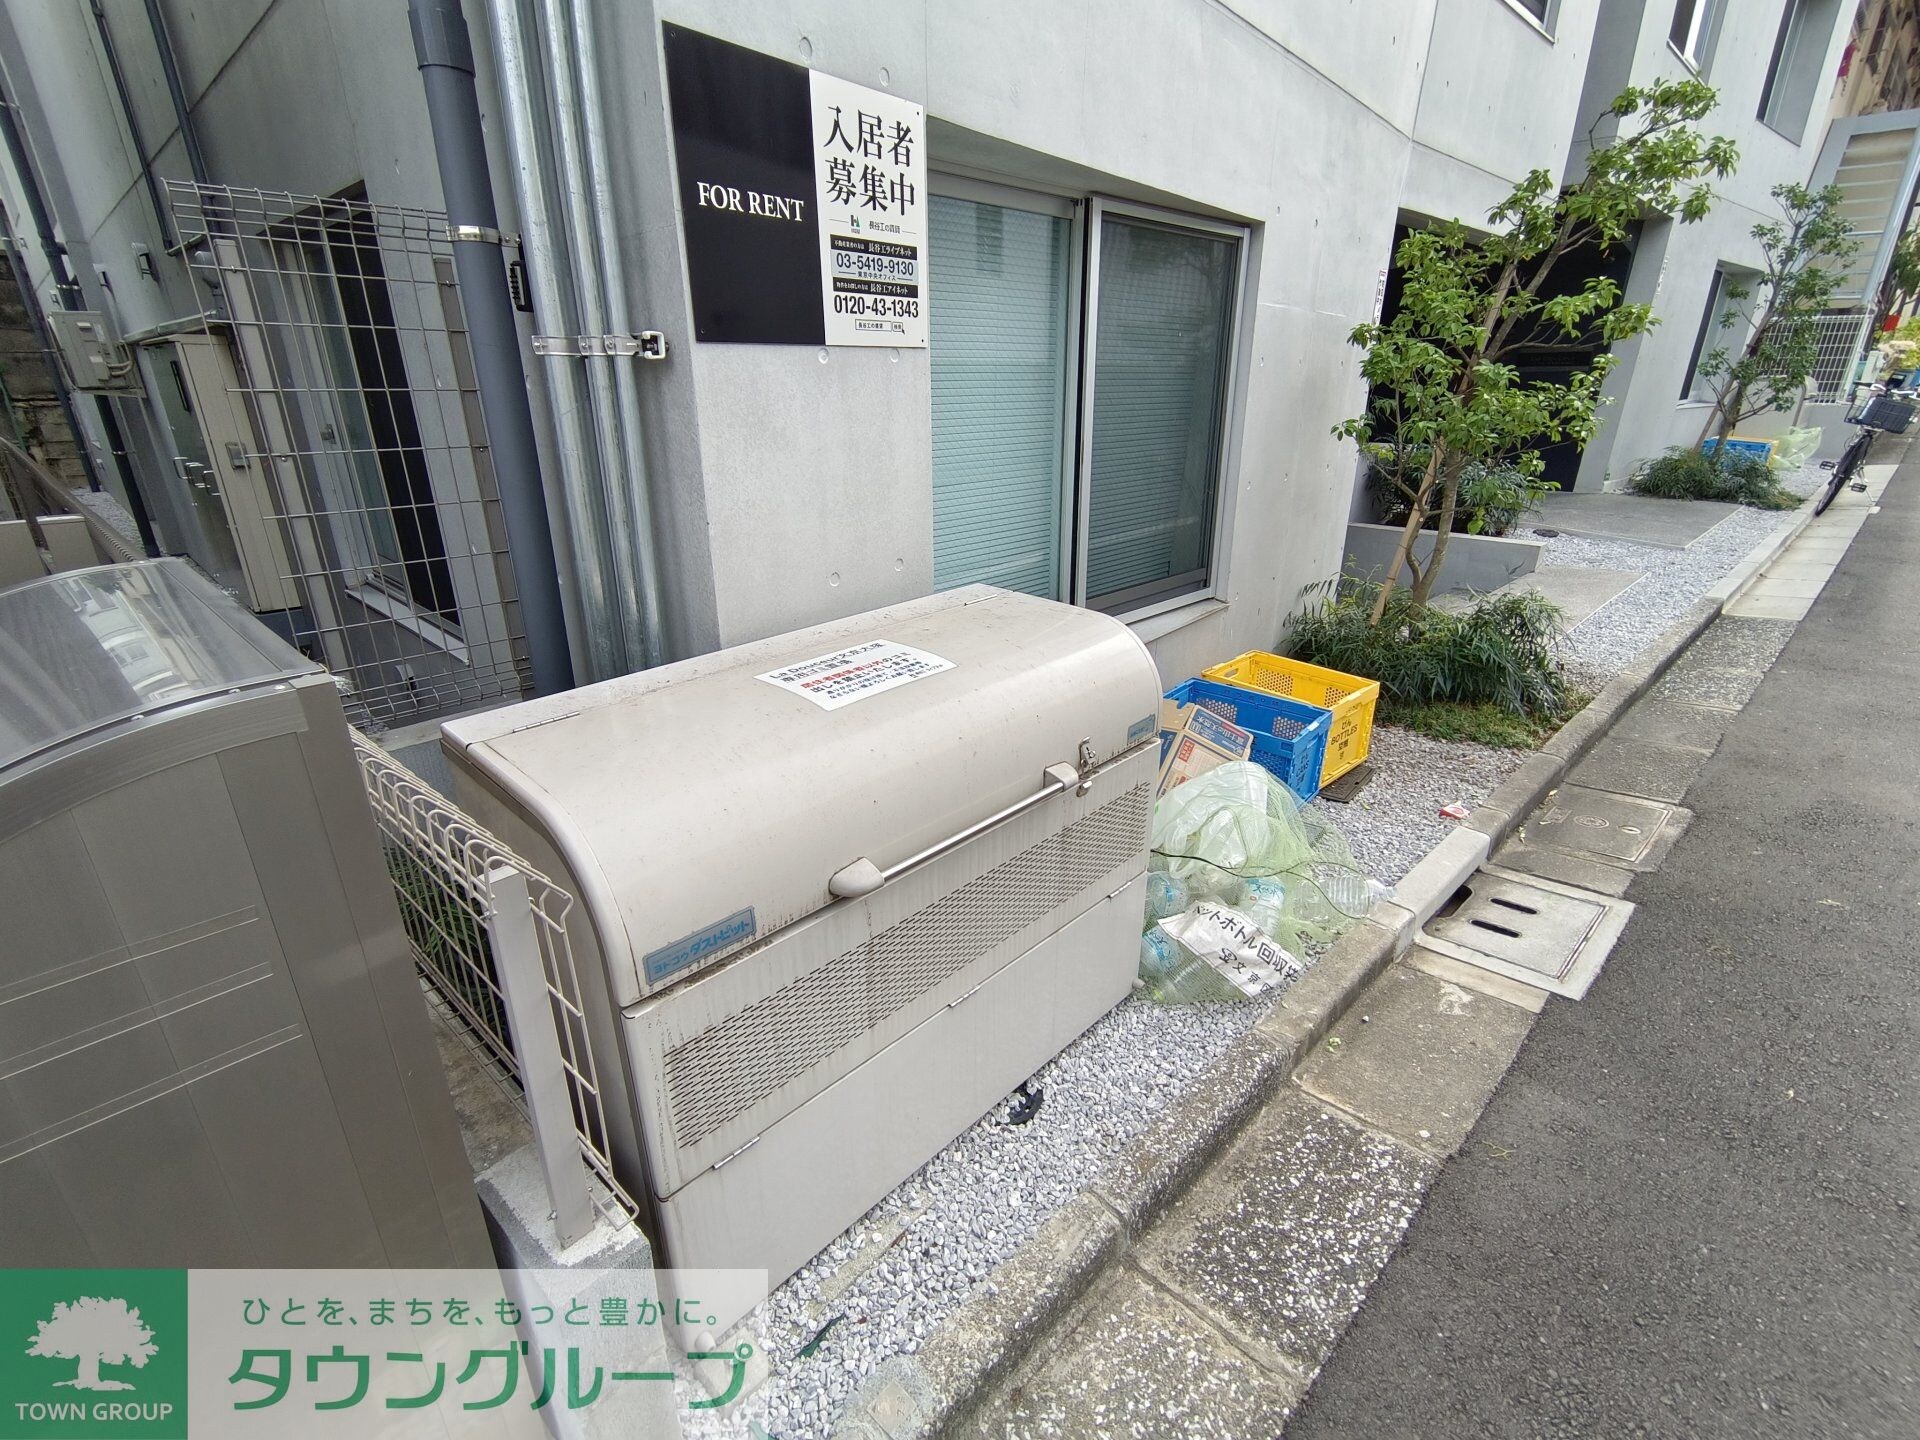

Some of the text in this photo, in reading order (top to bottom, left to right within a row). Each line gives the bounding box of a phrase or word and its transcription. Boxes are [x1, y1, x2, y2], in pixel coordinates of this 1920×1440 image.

[823, 105, 914, 168] 入居者
[824, 156, 915, 216] 募集中
[697, 181, 805, 222] FOR RENT
[836, 252, 914, 276] 03-5419-9130
[870, 283, 909, 295] 長谷工アイネット
[834, 295, 919, 318] 0120-43-1343
[1330, 724, 1358, 745] BOTTLES
